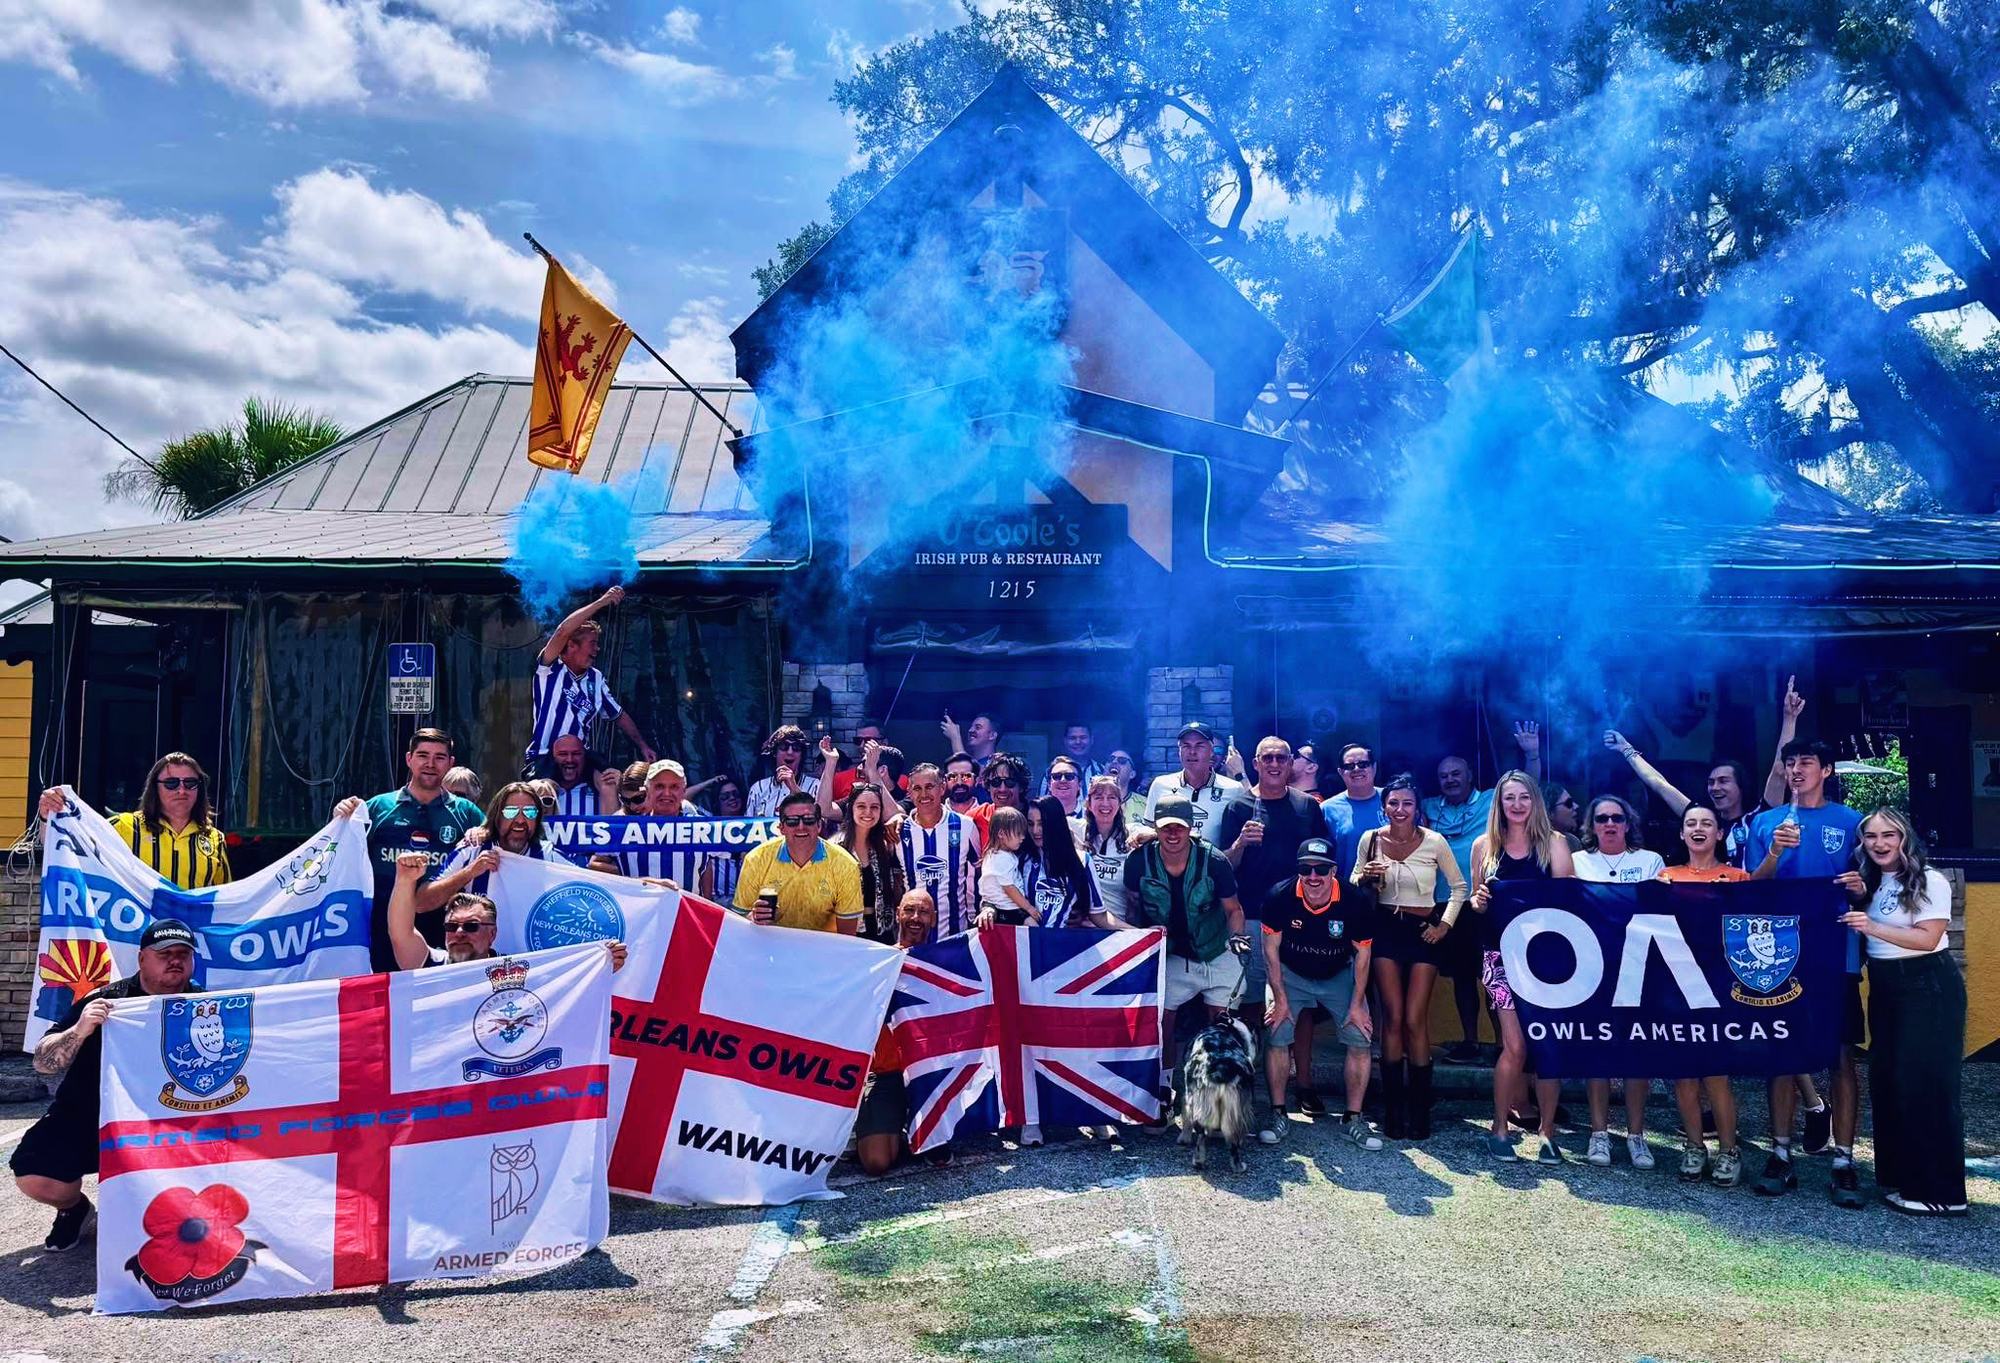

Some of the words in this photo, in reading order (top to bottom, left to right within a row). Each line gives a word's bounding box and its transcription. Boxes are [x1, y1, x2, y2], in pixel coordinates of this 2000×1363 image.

[915, 552, 957, 565] IRISH
[959, 552, 988, 565] PUB
[991, 552, 1003, 565] &
[1005, 552, 1102, 565] RESTAURANT
[988, 580, 1036, 599] 1215
[542, 821, 612, 845] WLS
[542, 888, 581, 912] SHEFFIELD
[582, 889, 618, 925] WEDNESDAY
[1037, 892, 1063, 910] Eyup
[229, 902, 350, 962] OWLS
[533, 919, 554, 930] NEW
[553, 924, 592, 940] ORLEANS
[1528, 1021, 1614, 1041] OWLS
[1629, 1019, 1790, 1043] AMERICAS
[610, 1009, 740, 1060] RLEANS
[748, 1042, 861, 1091] OWLS
[492, 1060, 534, 1073] VETERAN
[164, 1097, 201, 1110] CONSILIO
[215, 1091, 244, 1107] ANIMIS
[678, 1119, 837, 1176] WAWAW
[433, 1251, 509, 1272] ARMED
[515, 1242, 582, 1264] FORCES
[172, 1287, 190, 1298] We
[194, 1270, 236, 1295] Forget
